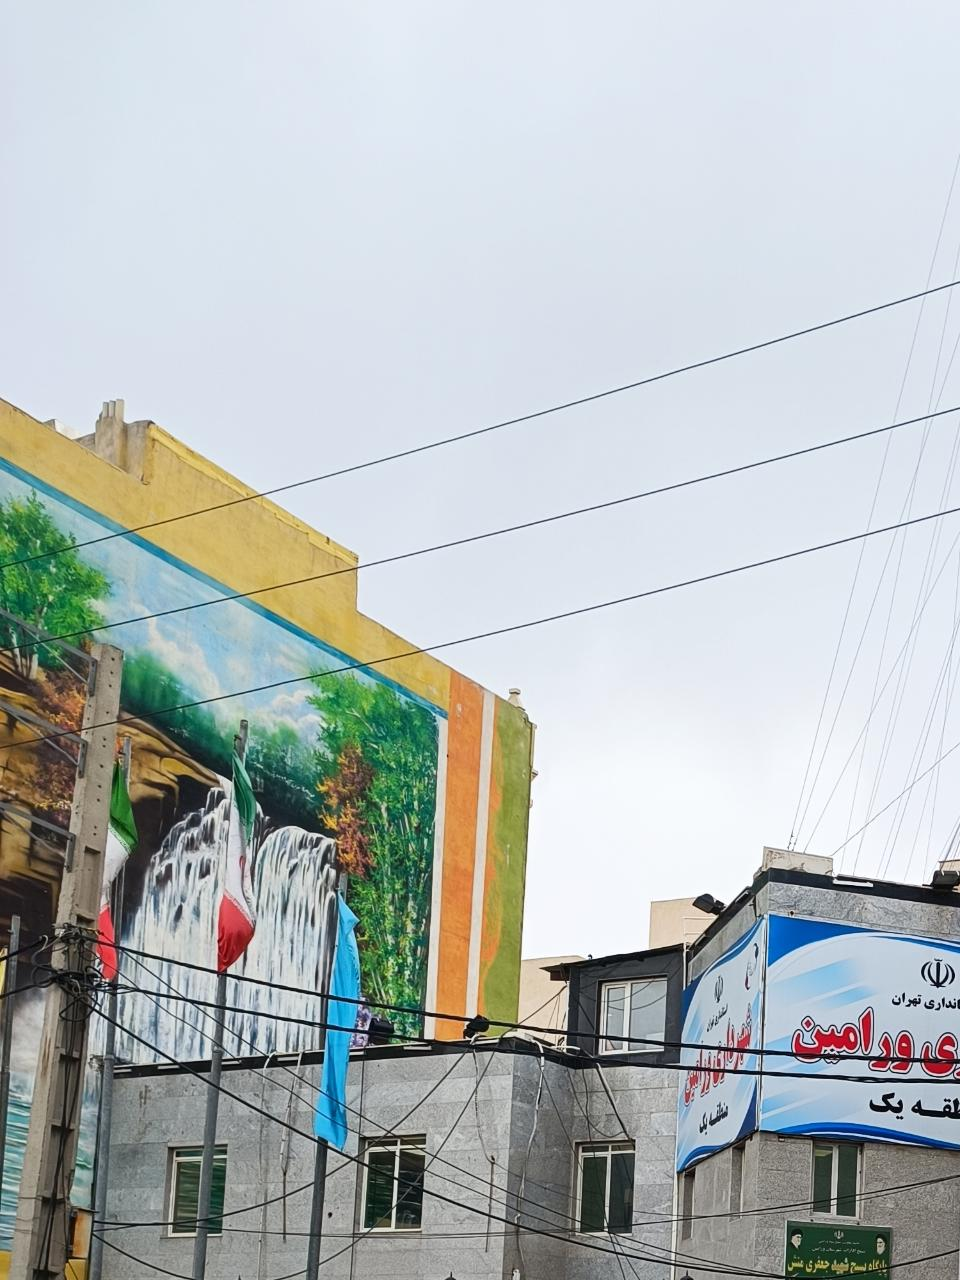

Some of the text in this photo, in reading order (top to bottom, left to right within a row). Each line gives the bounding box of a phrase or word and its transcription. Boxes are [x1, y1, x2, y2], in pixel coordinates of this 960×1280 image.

[892, 993, 922, 1007] تهران
[791, 1006, 915, 1075] ورامین
[869, 1092, 904, 1120] یک
